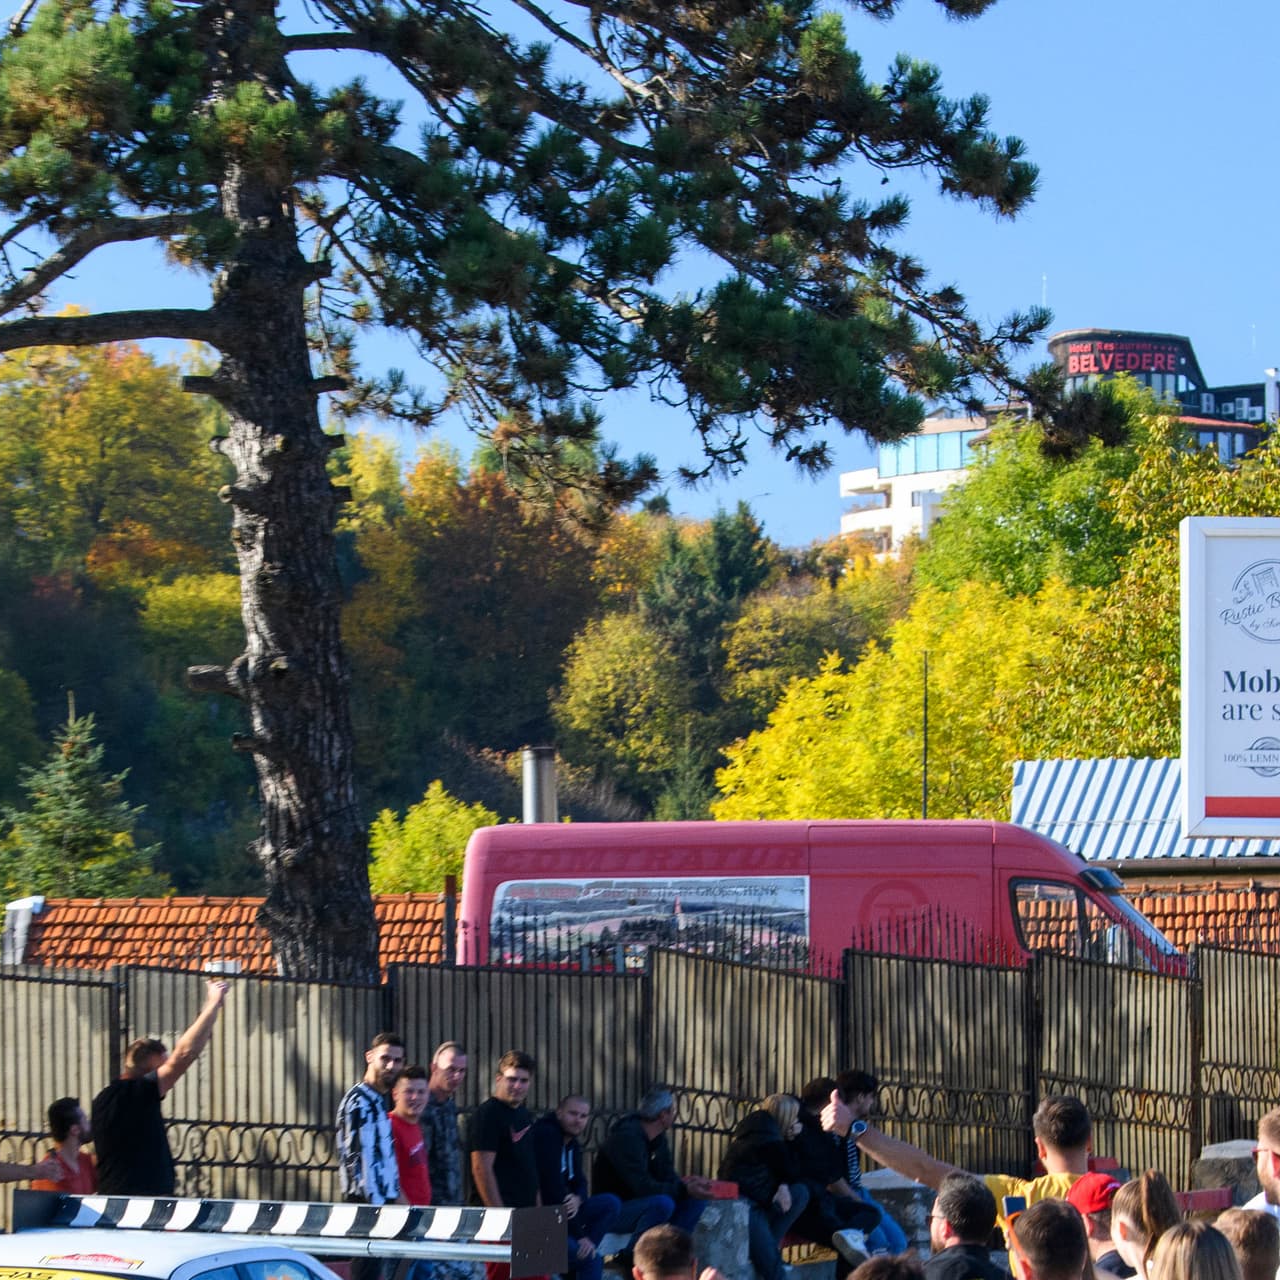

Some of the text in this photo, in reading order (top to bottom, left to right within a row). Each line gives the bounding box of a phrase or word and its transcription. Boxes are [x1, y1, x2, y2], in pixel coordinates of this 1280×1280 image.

[1068, 352, 1177, 374] BELVEDERE
[1219, 603, 1265, 627] Rustic
[1222, 701, 1265, 722] are
[1223, 753, 1247, 763] 100%
[1249, 753, 1280, 763] LEMN
